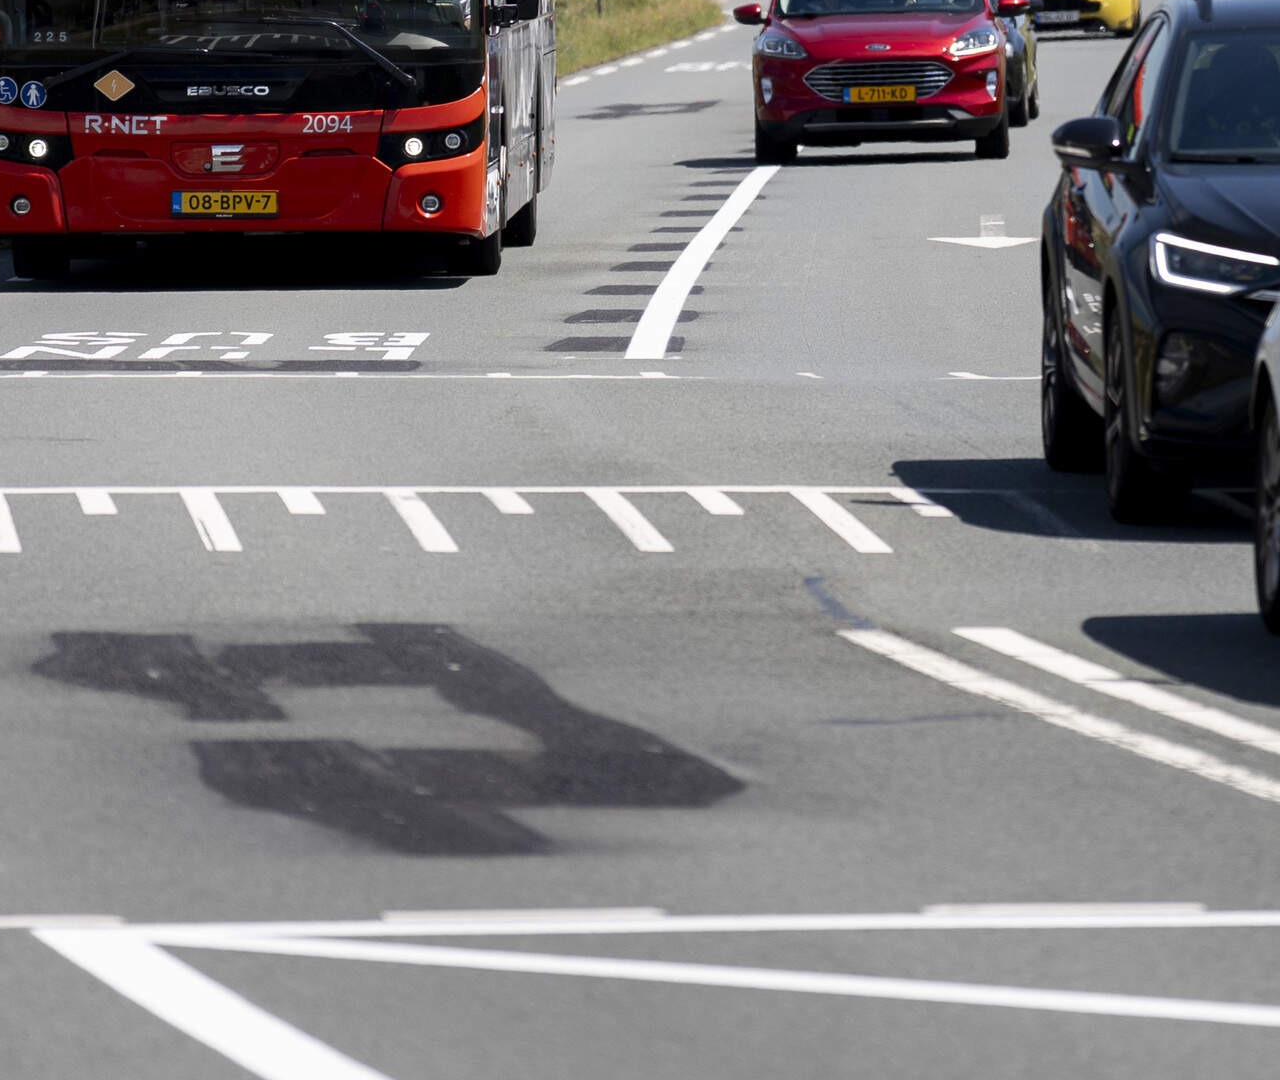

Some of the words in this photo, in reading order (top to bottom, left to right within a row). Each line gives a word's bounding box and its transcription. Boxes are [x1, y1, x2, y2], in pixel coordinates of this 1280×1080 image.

[34, 31, 67, 42] 225
[187, 86, 270, 96] EBUSCO
[302, 114, 353, 133] 2094
[189, 195, 272, 210] 08-BPV-7
